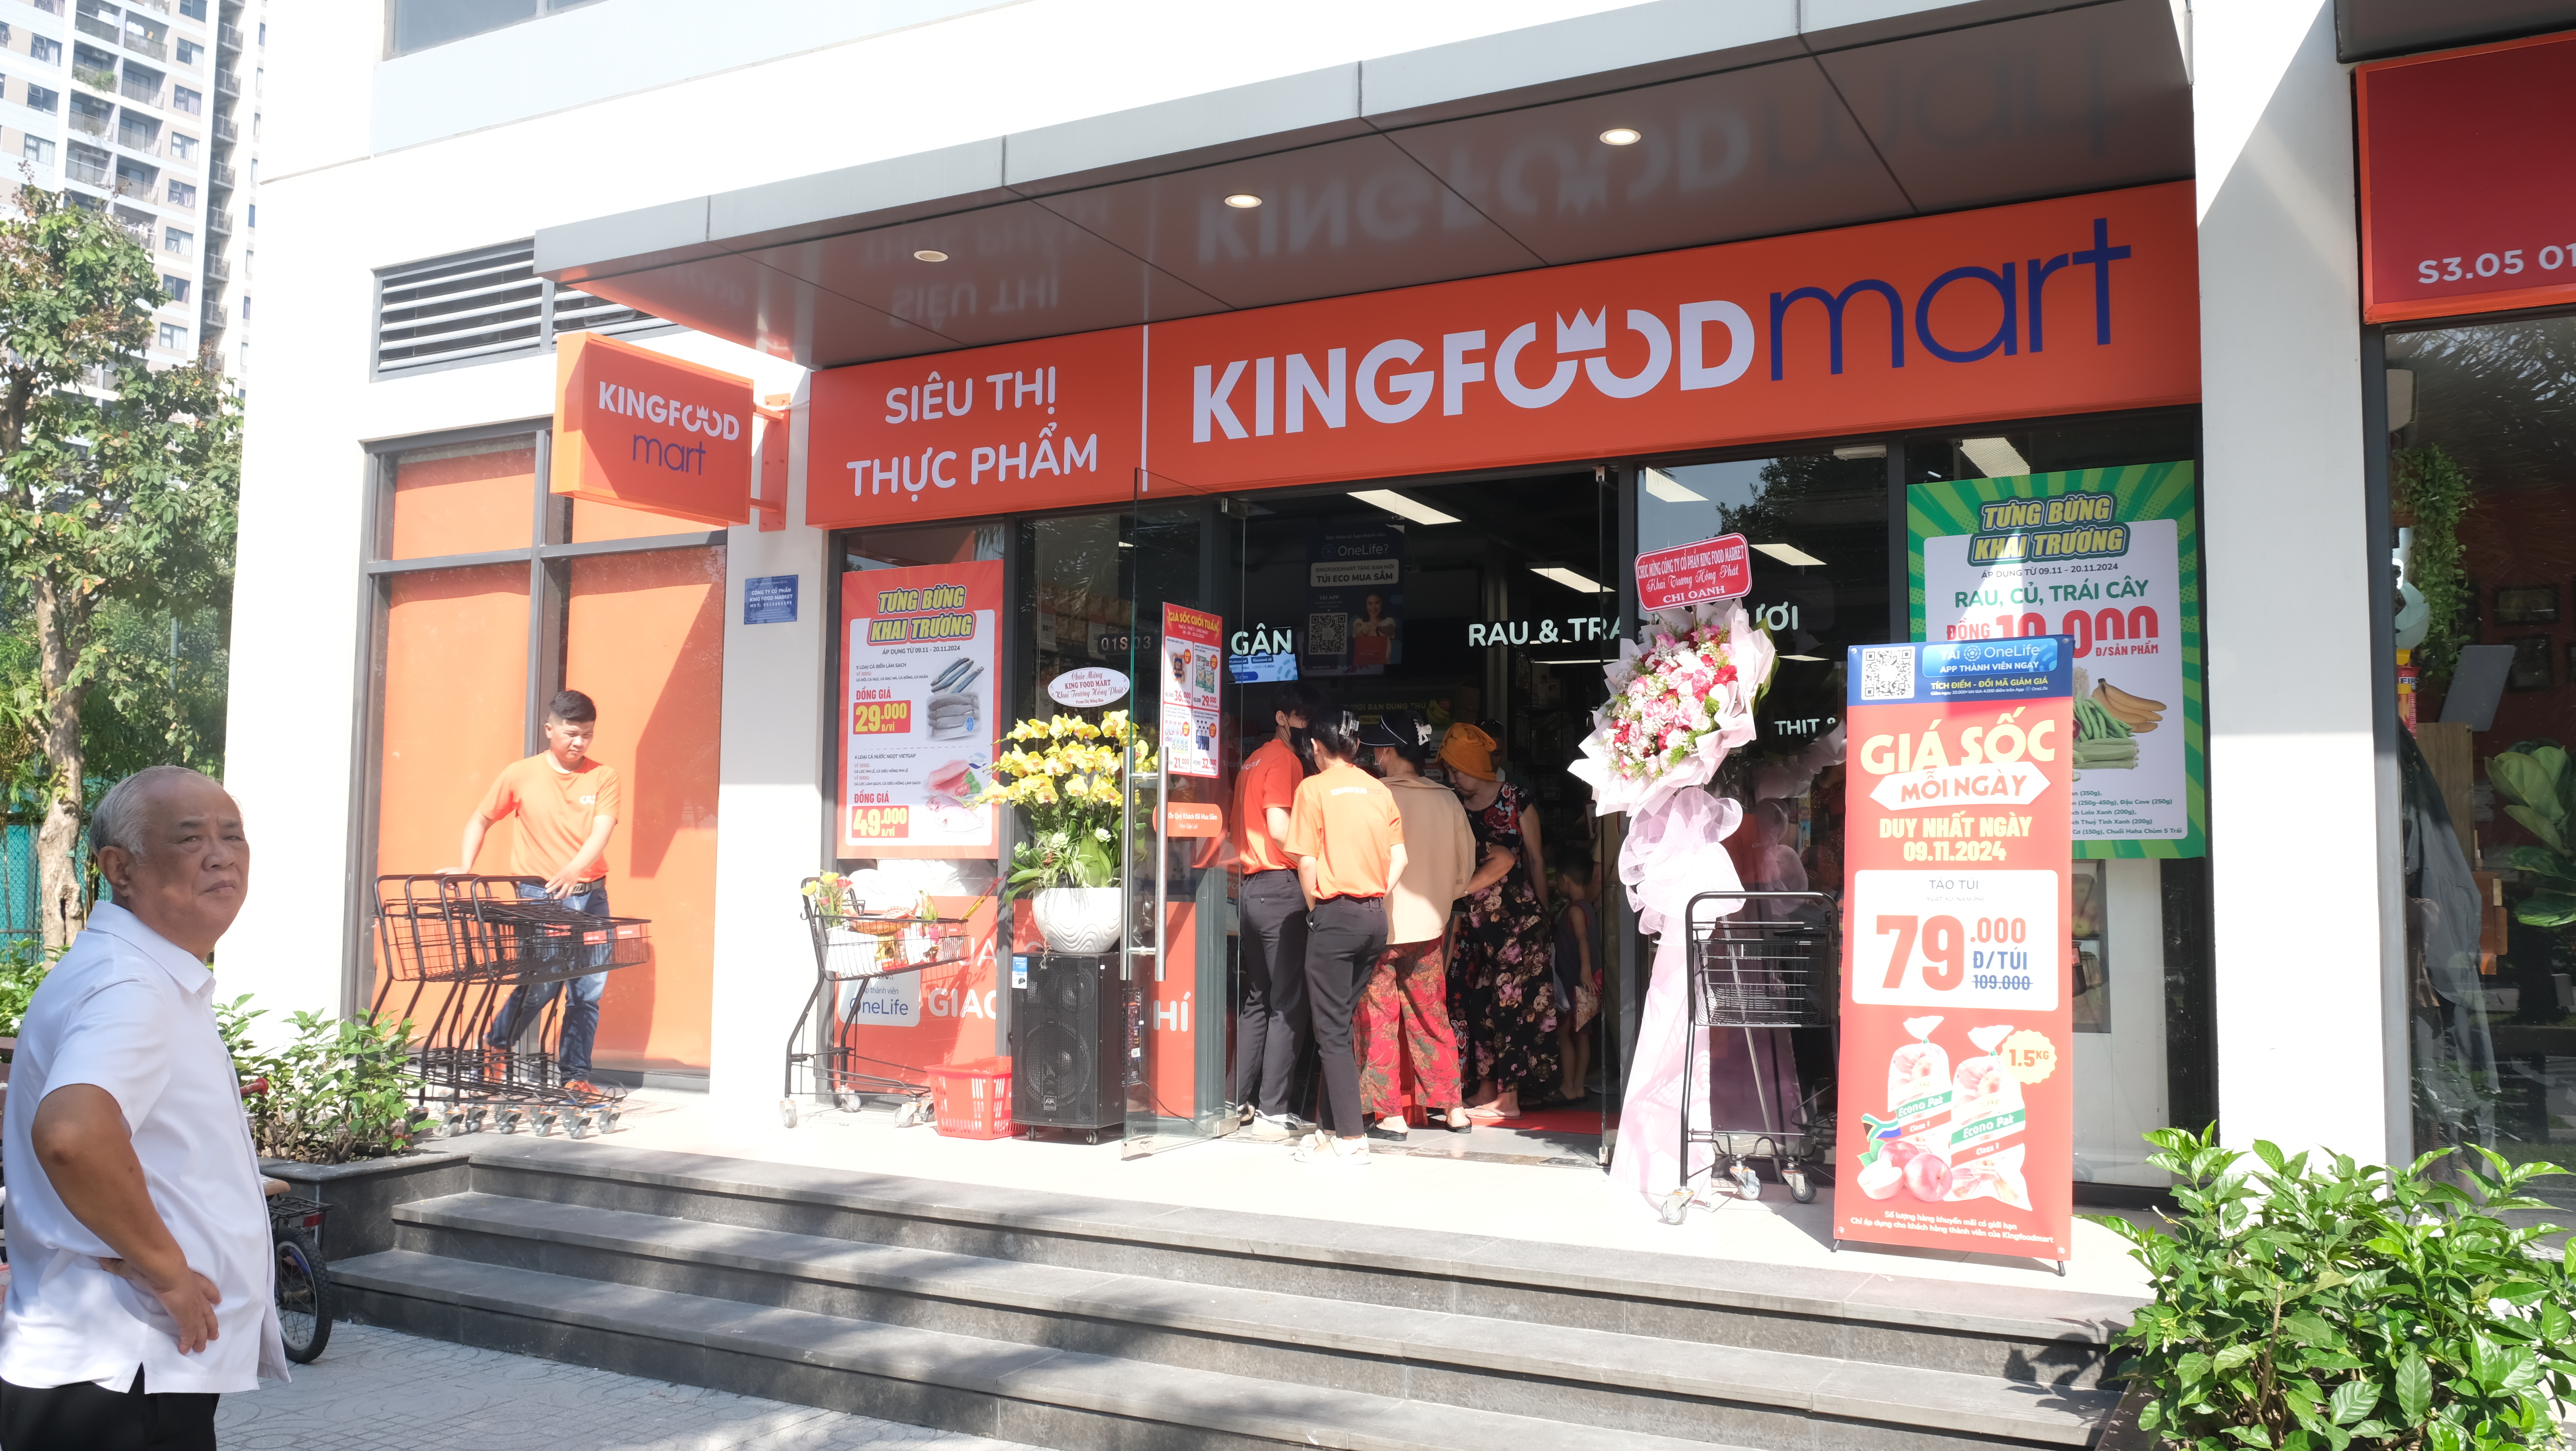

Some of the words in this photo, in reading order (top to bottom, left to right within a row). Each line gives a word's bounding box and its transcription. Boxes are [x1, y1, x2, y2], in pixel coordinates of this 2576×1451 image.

[2418, 249, 2524, 284] S3.05
[885, 370, 973, 425] SIÊU
[985, 365, 1057, 415] THỊ
[598, 380, 740, 441] KINGFOOD
[633, 434, 706, 476] mart
[846, 450, 956, 502] THỰC
[970, 420, 1097, 486] PHẨM
[1974, 535, 2029, 560] KHAI
[1637, 561, 1649, 579] CHÚC
[1649, 559, 1661, 577] MỪNG
[1661, 557, 1674, 574] CÔNG
[1674, 558, 1679, 572] TY
[1700, 552, 1711, 566] KING
[1711, 549, 1724, 565] FOOD
[1725, 545, 1744, 562] MARKET
[1982, 569, 1993, 579] ÁP
[1996, 569, 2022, 579] DỤNG
[2024, 567, 2037, 576] TỪ
[2039, 567, 2062, 575] 09.11
[2071, 563, 2118, 573] 20.11.2024
[1317, 574, 1330, 583] TÚI
[1646, 578, 1666, 592] Khai
[1719, 564, 1739, 579] Phát
[1662, 593, 1685, 602] CHỊ
[1688, 586, 1726, 599] OANH
[1955, 590, 2003, 608] RAU,
[2010, 582, 2044, 606] CỦ,
[2049, 579, 2099, 603] TRÁI
[2106, 575, 2148, 598] CÂY
[1168, 611, 1179, 622] GIÁ
[1180, 611, 1190, 624] SỐC
[870, 619, 908, 642] KHAI
[1468, 620, 1529, 647] RAU
[1539, 618, 1558, 643] &
[1947, 618, 1990, 640] ĐỒNG
[1984, 644, 2040, 658] OneLife
[2095, 643, 2129, 658] Đ/SẢN
[2131, 638, 2158, 655] PHẨM
[1960, 663, 1990, 671] THÀNH
[1992, 661, 2012, 670] VIÊN
[2014, 661, 2039, 670] NGAY
[856, 686, 876, 700] ĐỒNG
[878, 686, 891, 699] GIÁ
[1930, 681, 1950, 689] TÍCH
[1951, 679, 1971, 688] ĐIỂM
[1996, 678, 2008, 686] MÃ
[2034, 675, 2048, 685] GIÁ
[1774, 718, 1821, 738] THỊT
[1860, 719, 1950, 775] GIÁ
[1961, 706, 2055, 765] SỐC
[854, 790, 874, 803] ĐỒNG
[877, 790, 889, 802] GIÁ
[1901, 770, 1948, 802] MỖI
[1954, 769, 2028, 797] NGÀY
[1880, 818, 1917, 838] DUY
[1923, 811, 1975, 837] NHẤT
[1979, 812, 2032, 837] NGÀY
[1903, 840, 2006, 861] 09.11.2024
[1929, 877, 1954, 889] TÁO
[1958, 877, 1979, 889] TÚI
[1973, 947, 2027, 970] Đ/TÚI
[1973, 975, 2032, 991] 109.000
[1898, 1102, 1925, 1118] Econo
[1928, 1094, 1944, 1107] Pak
[1963, 1122, 1994, 1139] Econo
[1997, 1114, 2014, 1127] Pak
[1976, 1144, 1994, 1155] Class
[2002, 1232, 2054, 1243] Kingfoodmart
